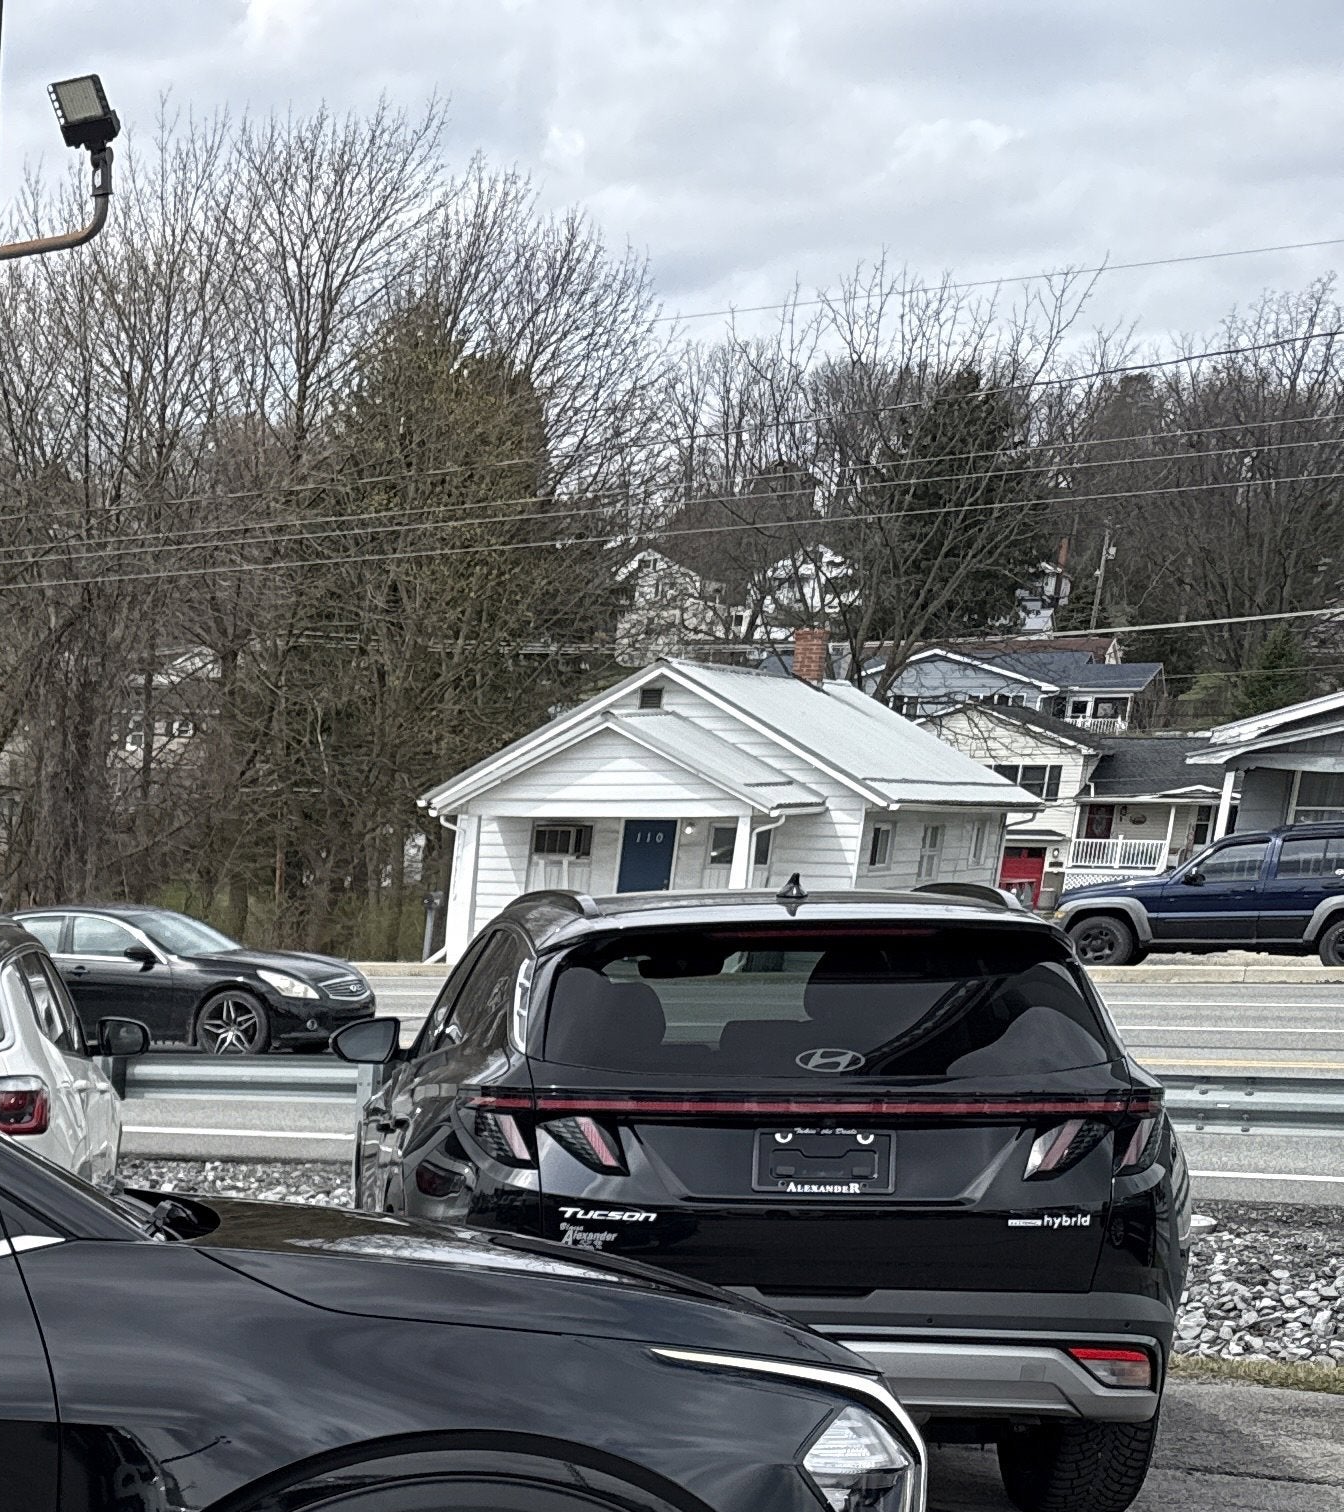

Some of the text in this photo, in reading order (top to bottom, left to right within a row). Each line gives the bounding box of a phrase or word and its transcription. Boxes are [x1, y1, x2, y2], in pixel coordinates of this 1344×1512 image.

[636, 831, 664, 843] 110
[786, 1181, 861, 1194] ALEXANDER
[1043, 1213, 1091, 1230] hybrid
[560, 1230, 619, 1246] Alexander
